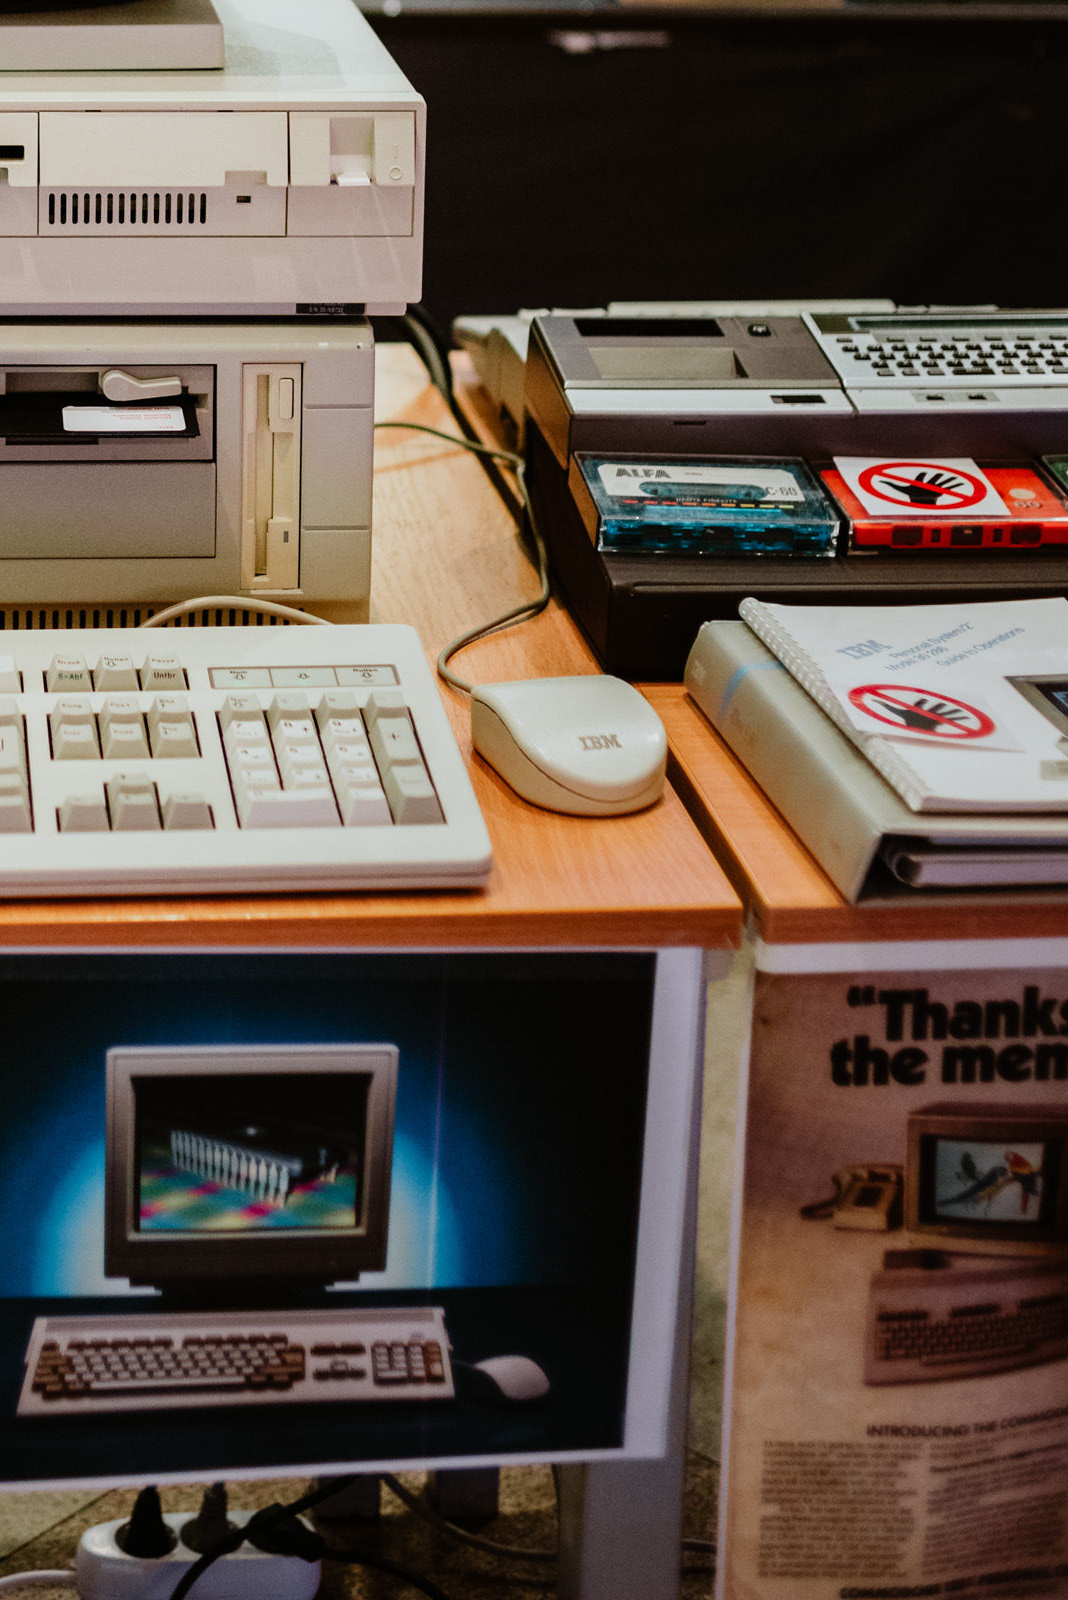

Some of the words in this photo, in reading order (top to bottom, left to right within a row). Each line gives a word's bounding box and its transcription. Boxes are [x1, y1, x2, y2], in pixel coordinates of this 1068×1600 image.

[616, 468, 672, 479] ALFA
[835, 639, 894, 660] IBM
[888, 636, 932, 660] Personal
[935, 651, 966, 668] Guide
[978, 626, 1027, 651] Operations
[884, 655, 917, 672] Model
[578, 733, 623, 751] IBM
[830, 1035, 929, 1086] the
